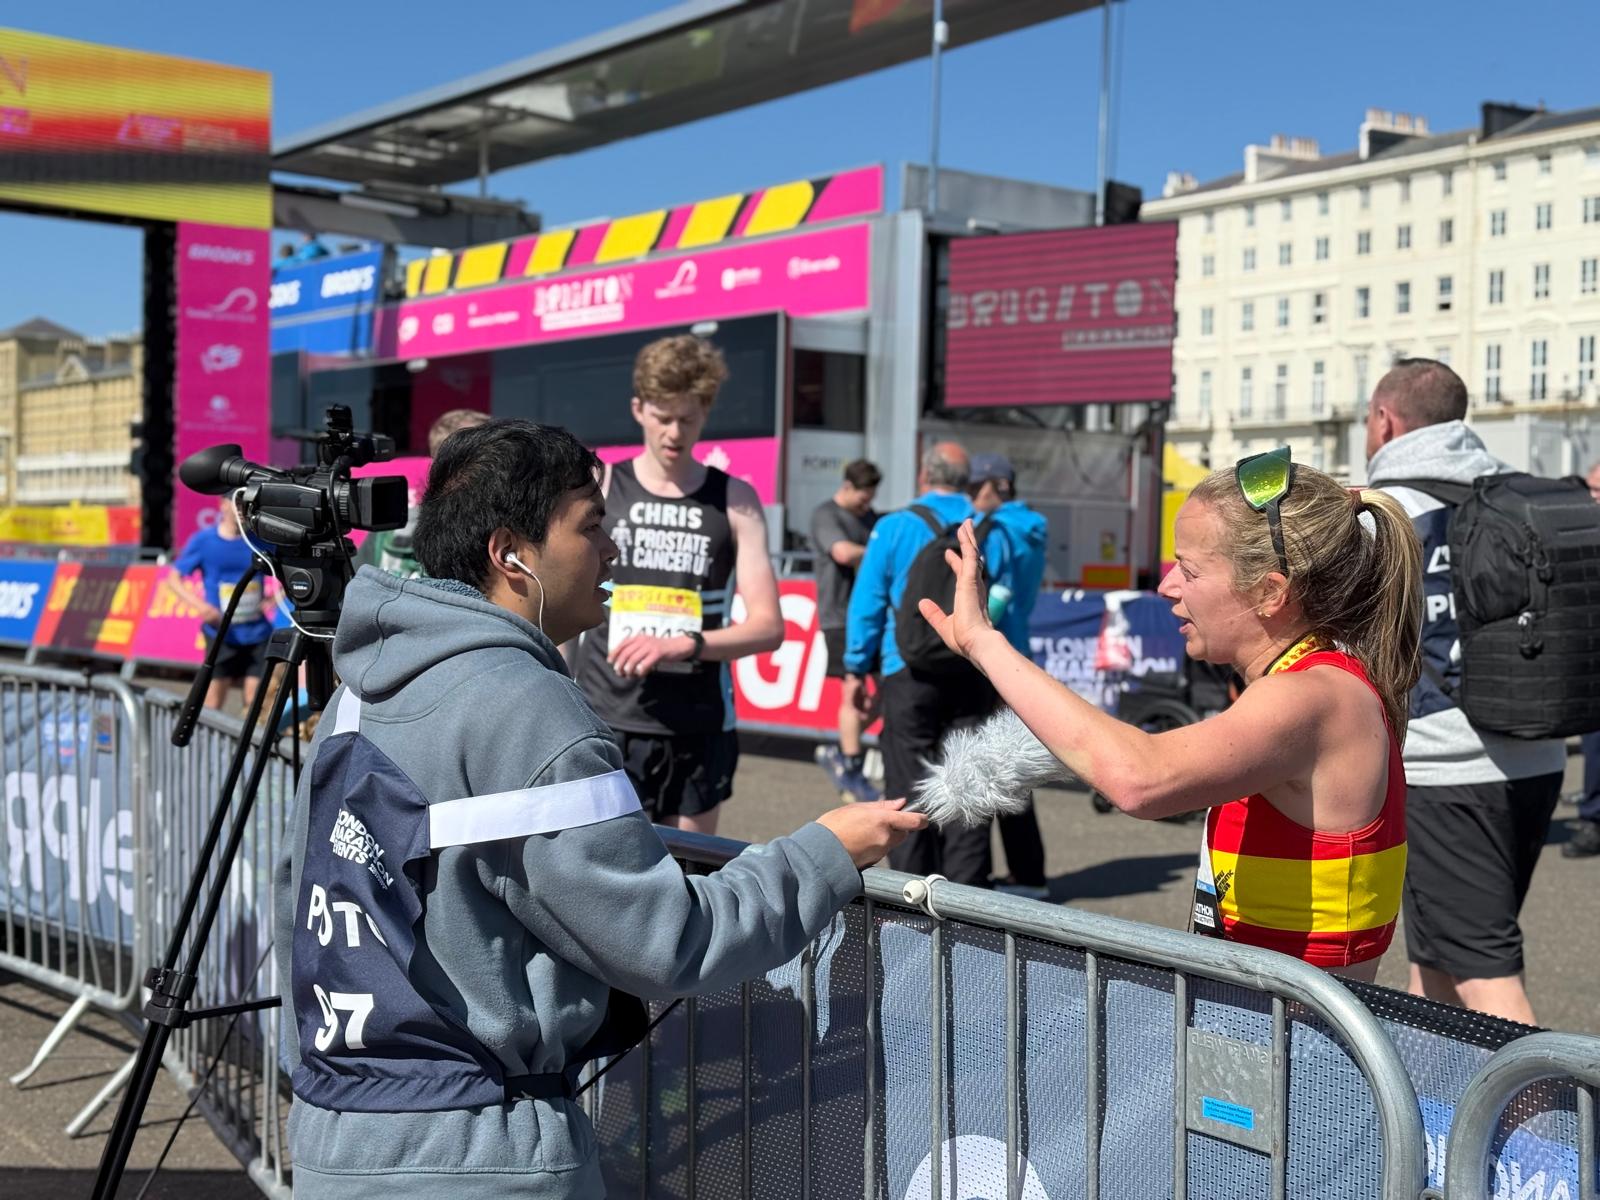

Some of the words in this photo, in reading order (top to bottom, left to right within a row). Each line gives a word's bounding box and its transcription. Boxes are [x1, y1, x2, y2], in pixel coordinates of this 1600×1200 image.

[629, 501, 703, 530] CHRIS
[634, 527, 711, 556] PROSTATE
[632, 546, 693, 574] CANCER
